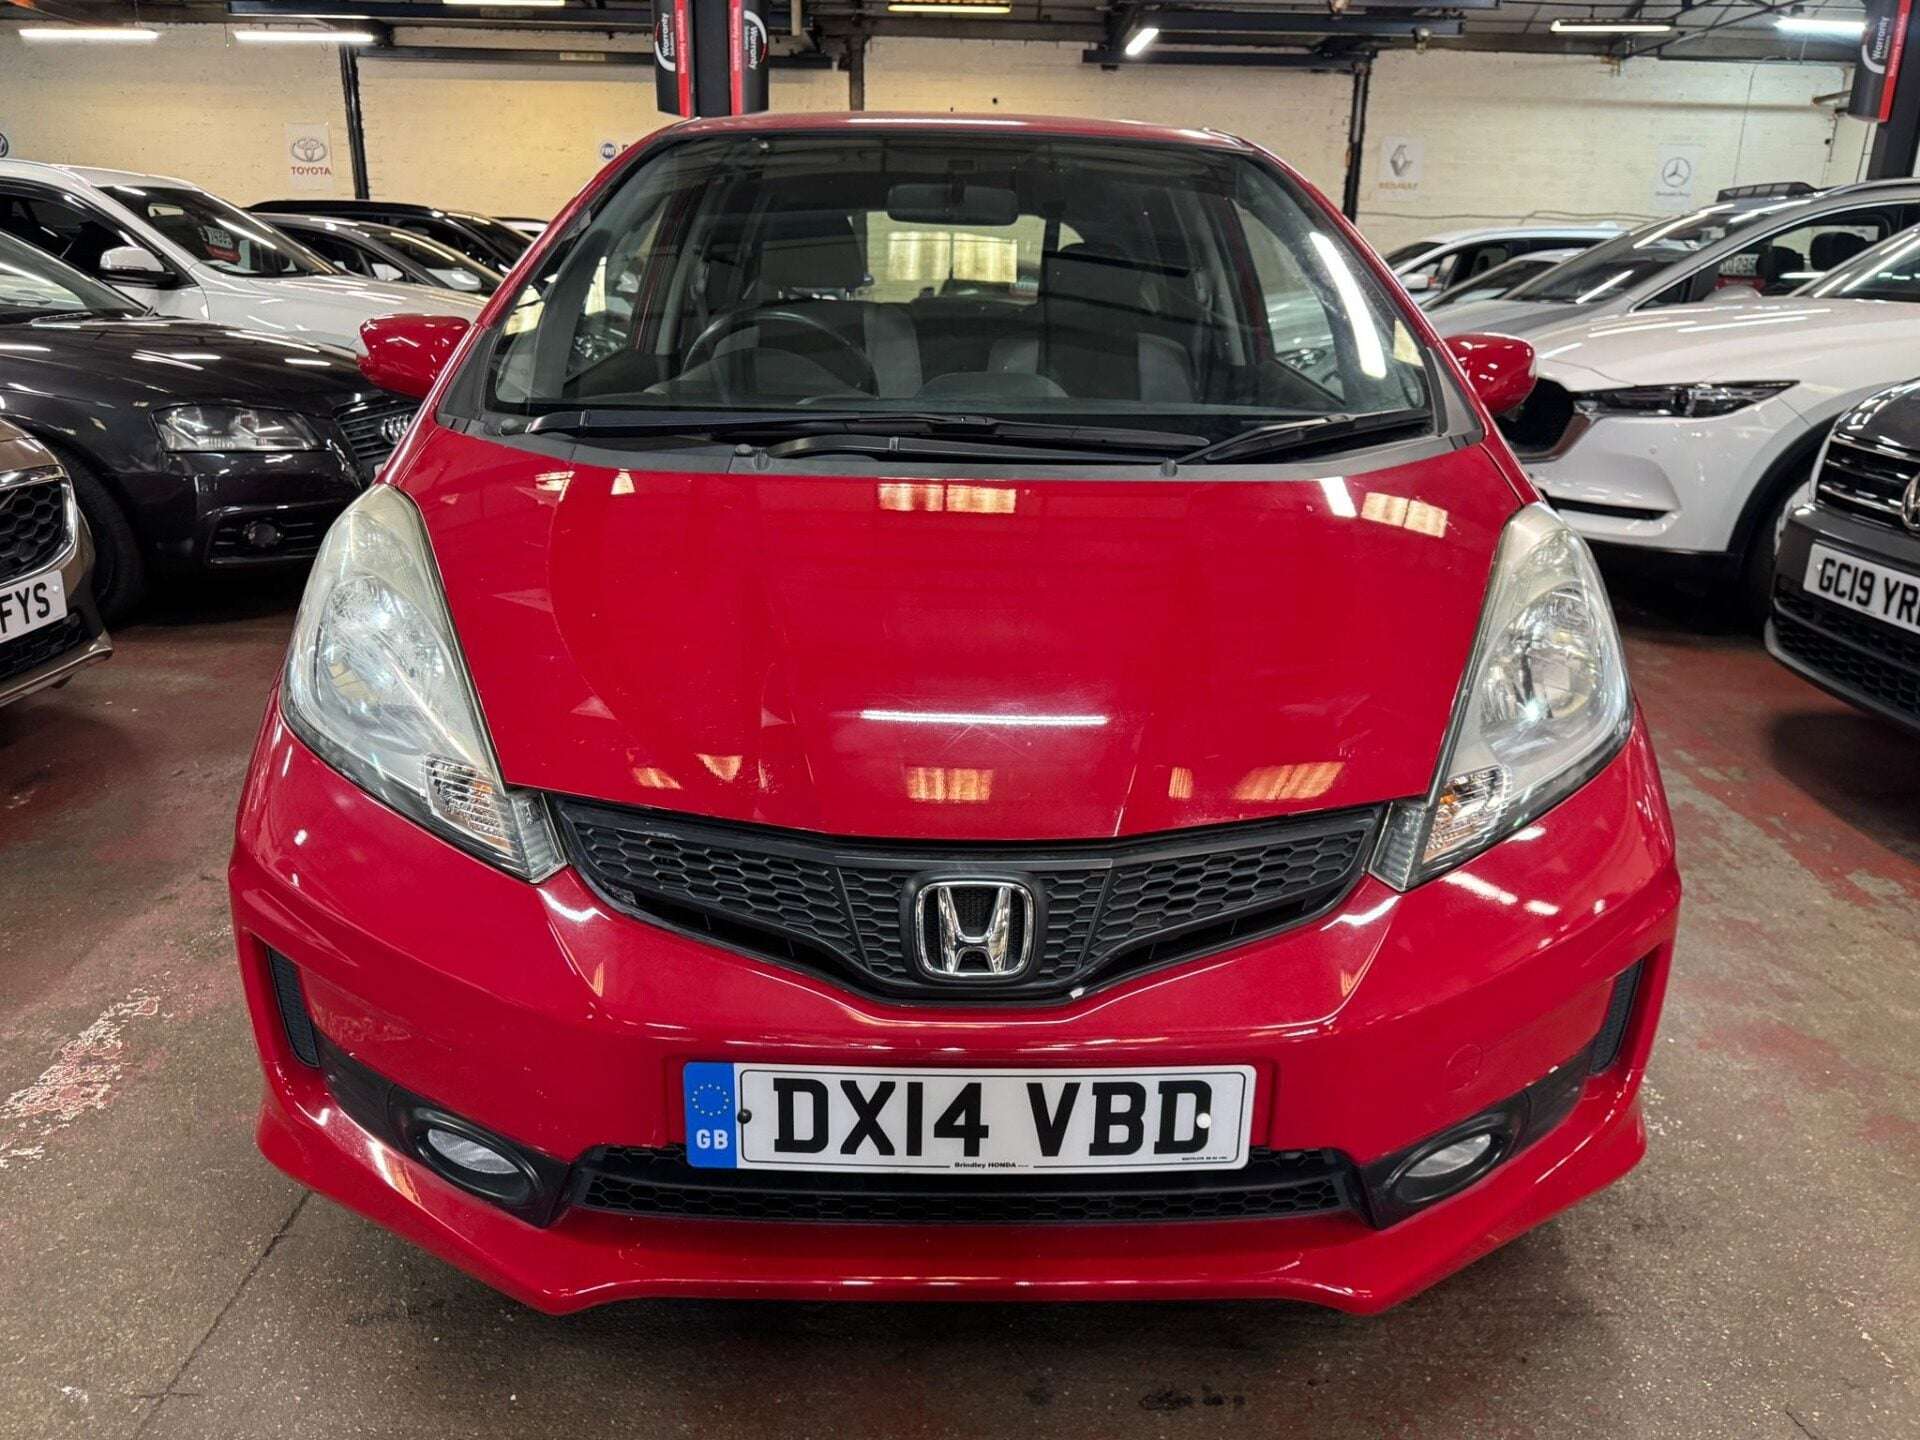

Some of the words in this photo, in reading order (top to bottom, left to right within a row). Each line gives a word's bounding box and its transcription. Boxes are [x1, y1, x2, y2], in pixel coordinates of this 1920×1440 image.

[661, 13, 670, 57] Warranty
[748, 26, 758, 70] Warranty
[1872, 16, 1890, 60] Warranty
[291, 166, 332, 176] TOYOTA
[0, 582, 51, 634] FYS
[1818, 557, 1875, 608] GC19
[1882, 576, 1920, 626] YR
[696, 1128, 729, 1151] GB
[773, 1077, 990, 1158] DX14
[1026, 1079, 1213, 1157] VBD
